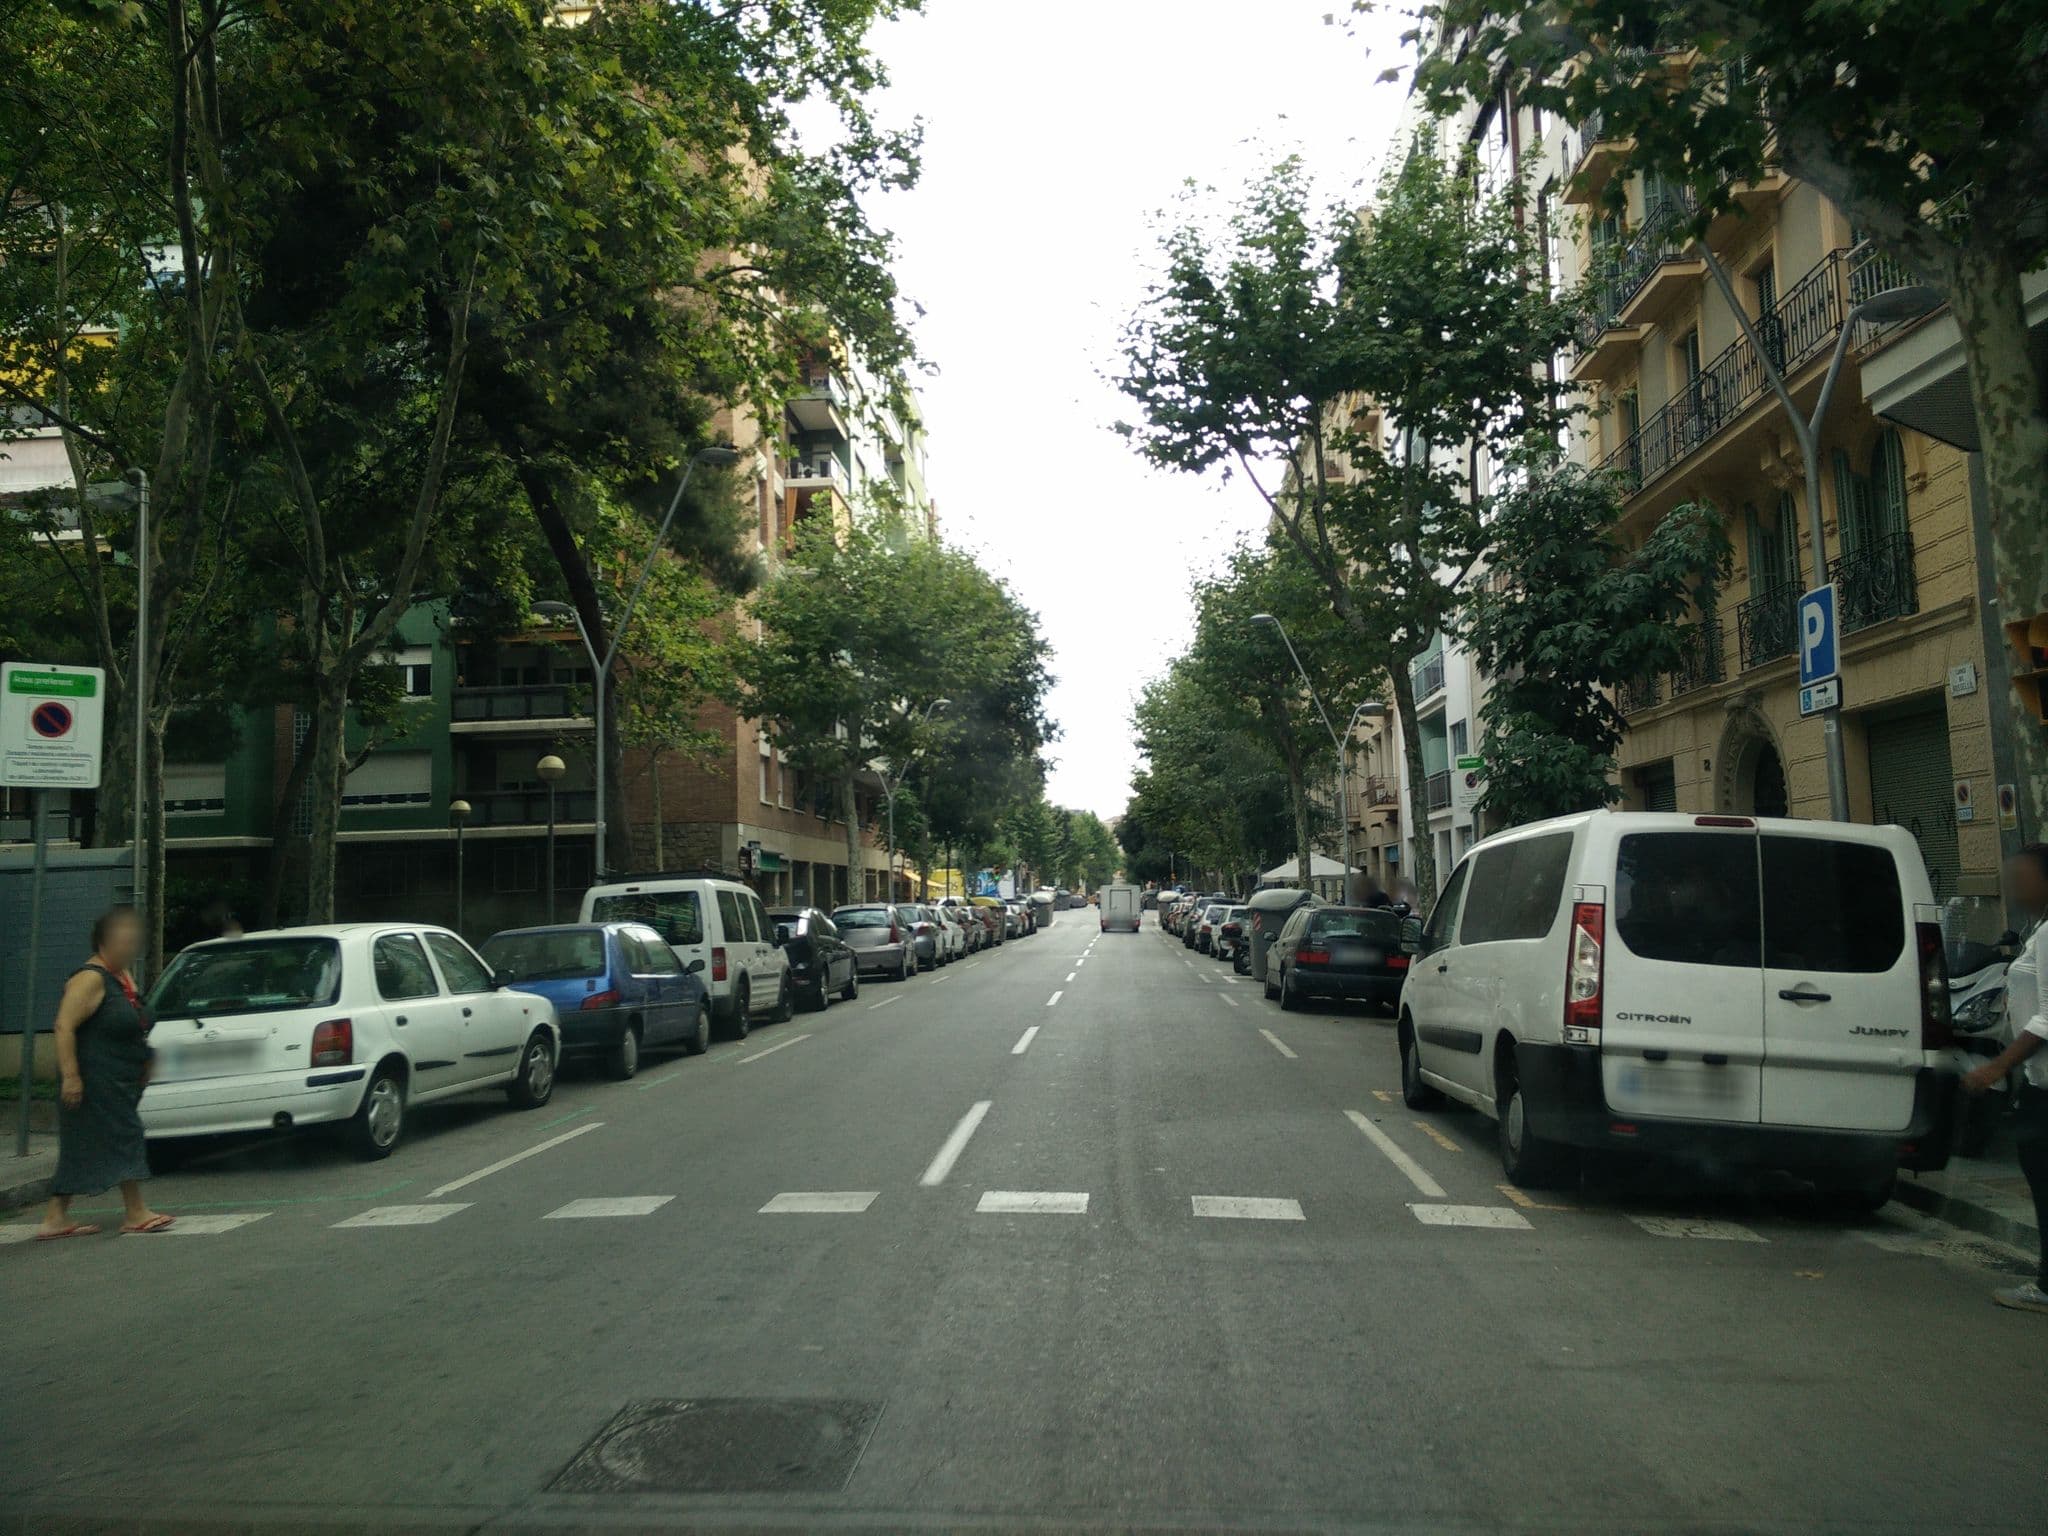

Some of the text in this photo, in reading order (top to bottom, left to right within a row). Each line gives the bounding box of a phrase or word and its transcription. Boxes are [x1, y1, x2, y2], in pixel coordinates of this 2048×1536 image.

[1803, 602, 1825, 673] P
[1616, 1012, 1692, 1025] CITROËN
[1849, 1026, 1909, 1038] JUMPY
